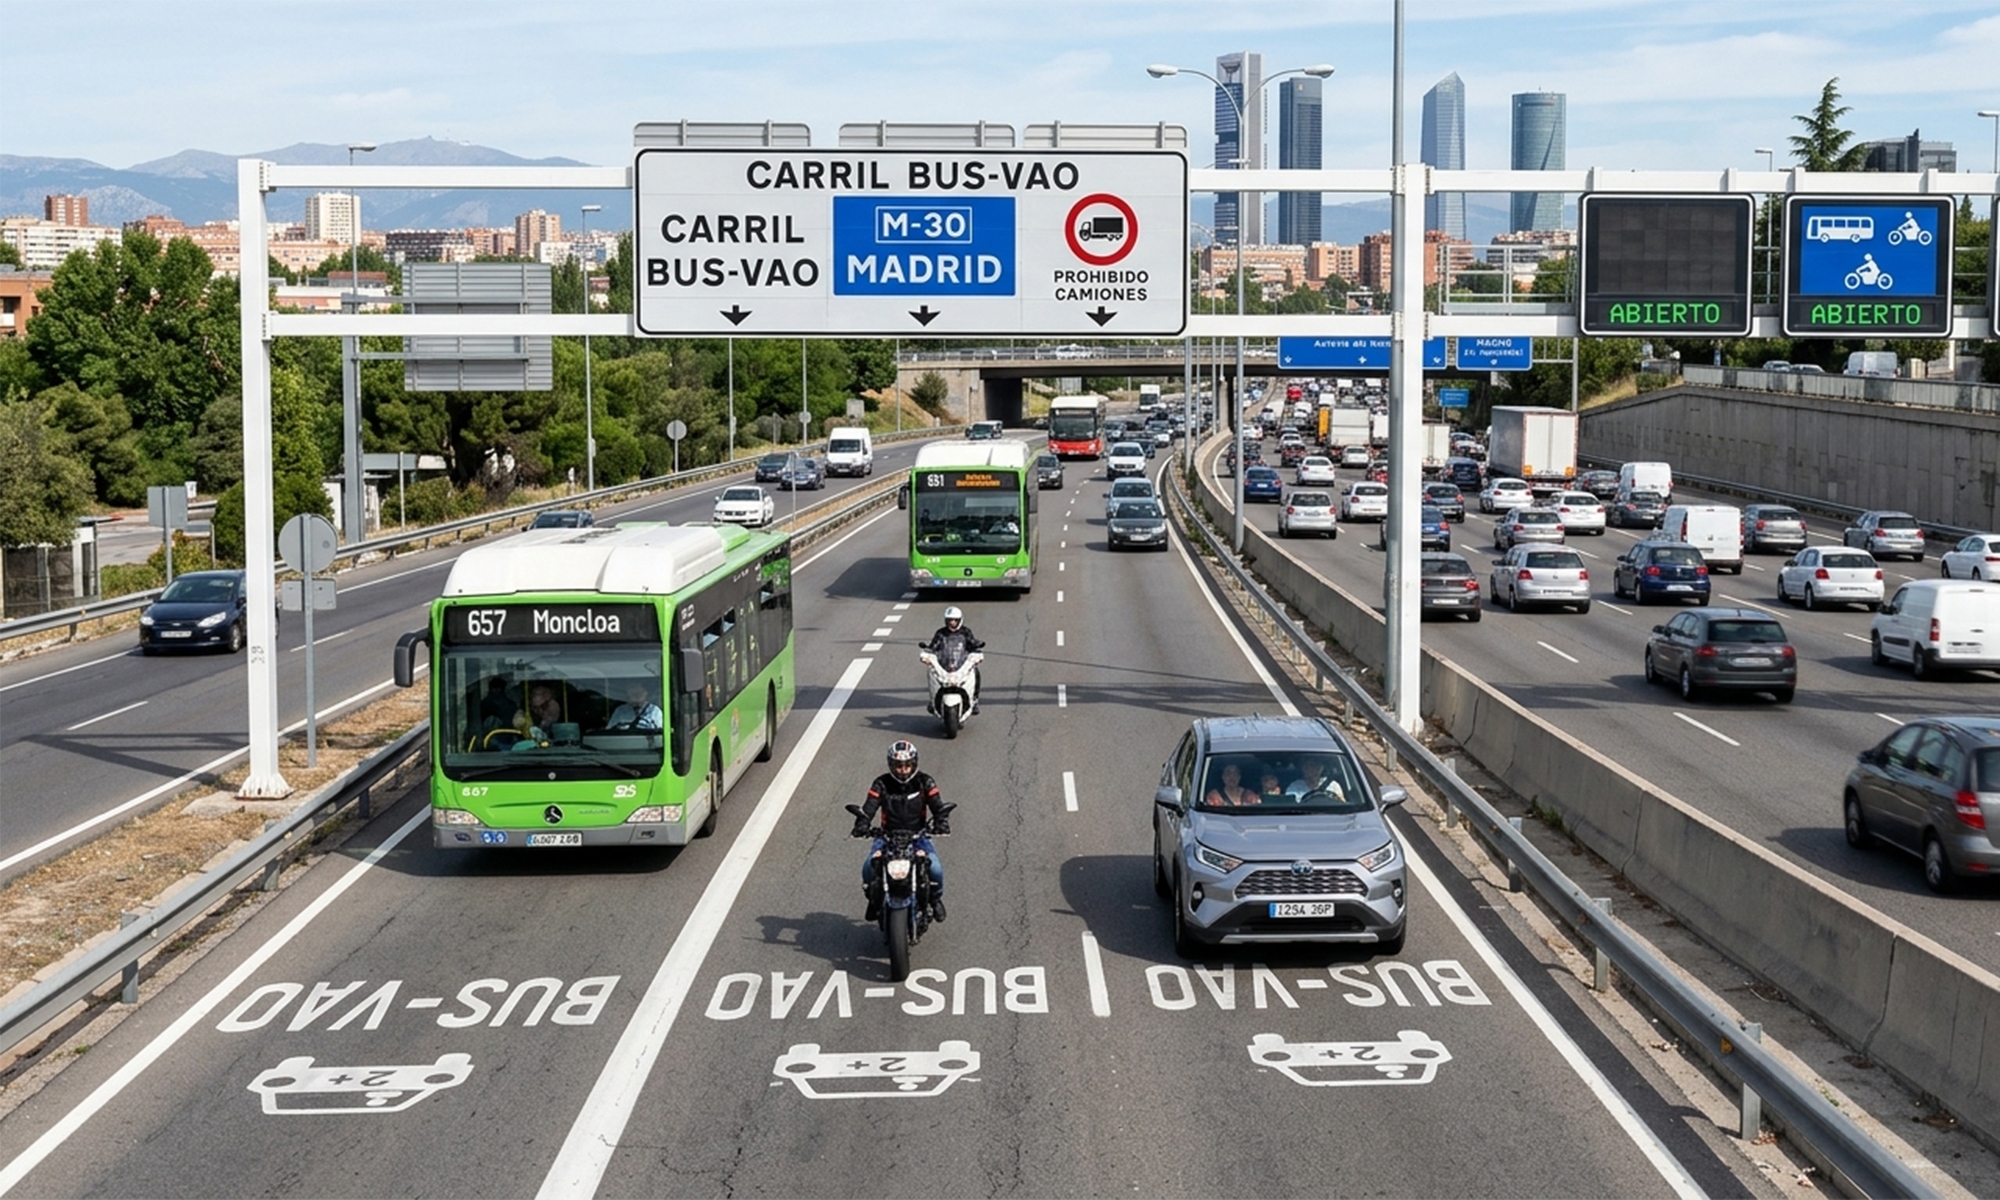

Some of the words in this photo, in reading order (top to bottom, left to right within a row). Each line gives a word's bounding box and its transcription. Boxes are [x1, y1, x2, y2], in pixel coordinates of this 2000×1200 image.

[746, 161, 889, 190] CARRIL
[908, 161, 1079, 190] BUS-VAO
[661, 214, 805, 244] CARRIL
[882, 212, 966, 238] M-30
[647, 257, 819, 287] BUS-VAO
[847, 254, 1002, 284] MADRID
[1054, 269, 1149, 284] PROHIBIDO
[1055, 287, 1148, 302] CAMIONES
[1609, 302, 1720, 324] ABIERTO
[1811, 303, 1921, 325] ABIERTO
[468, 609, 507, 636] 657
[533, 608, 621, 634] Moncloa
[704, 966, 1049, 1021] BUS-VAO
[1144, 960, 1493, 1010] BUS-VAO
[216, 975, 621, 1032] BUS-VAO
[846, 1057, 907, 1072] 2+
[1319, 1046, 1381, 1060] 2+
[329, 1070, 397, 1087] 2+
